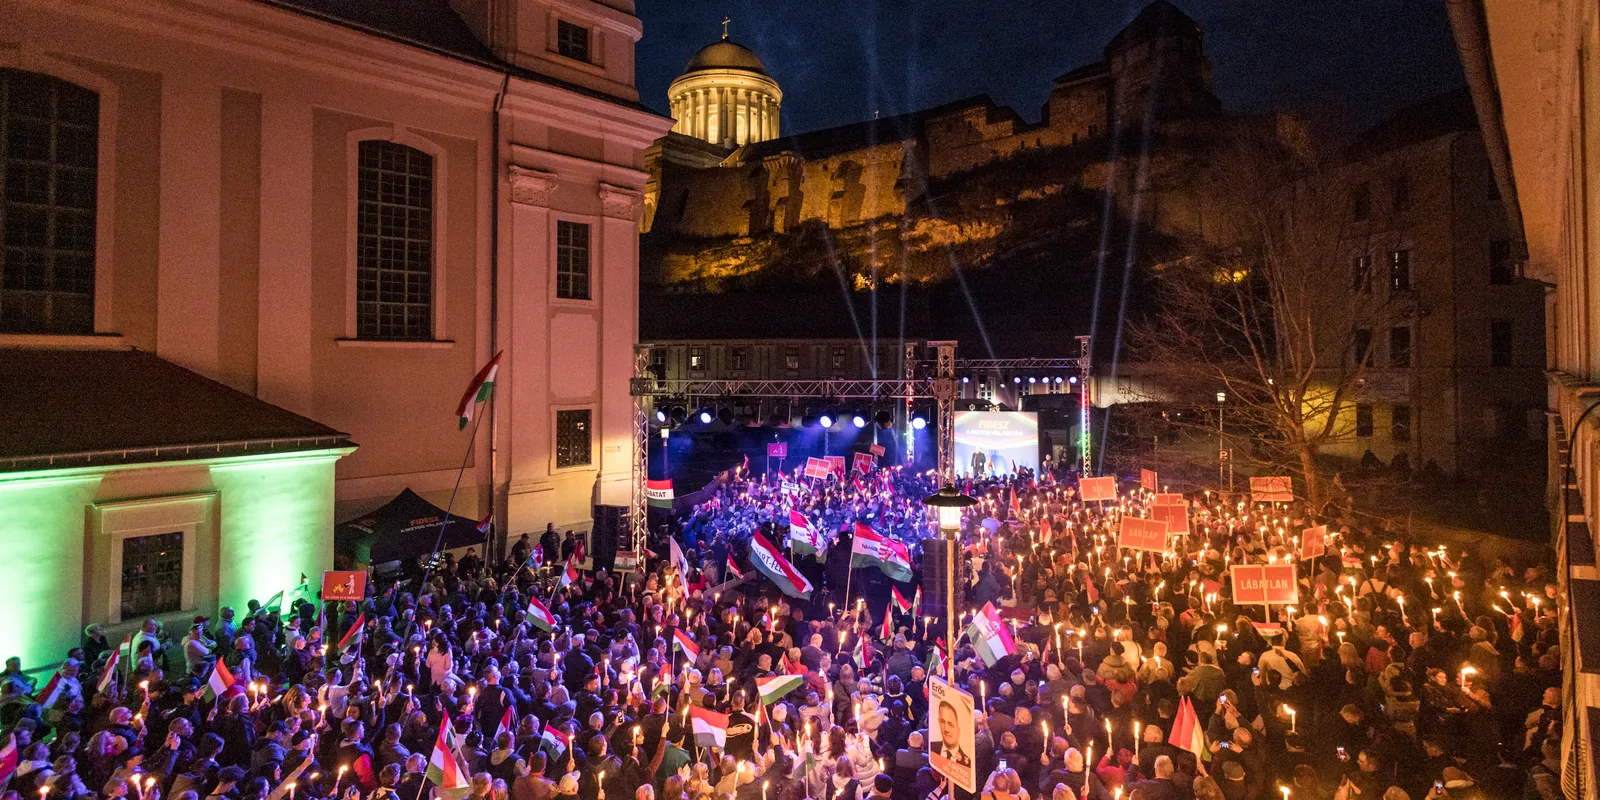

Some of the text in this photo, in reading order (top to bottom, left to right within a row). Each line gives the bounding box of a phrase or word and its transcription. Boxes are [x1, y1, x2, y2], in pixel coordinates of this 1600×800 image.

[979, 420, 1010, 429] FIDESZ
[1220, 451, 1228, 459] P
[932, 682, 946, 697] Erős
